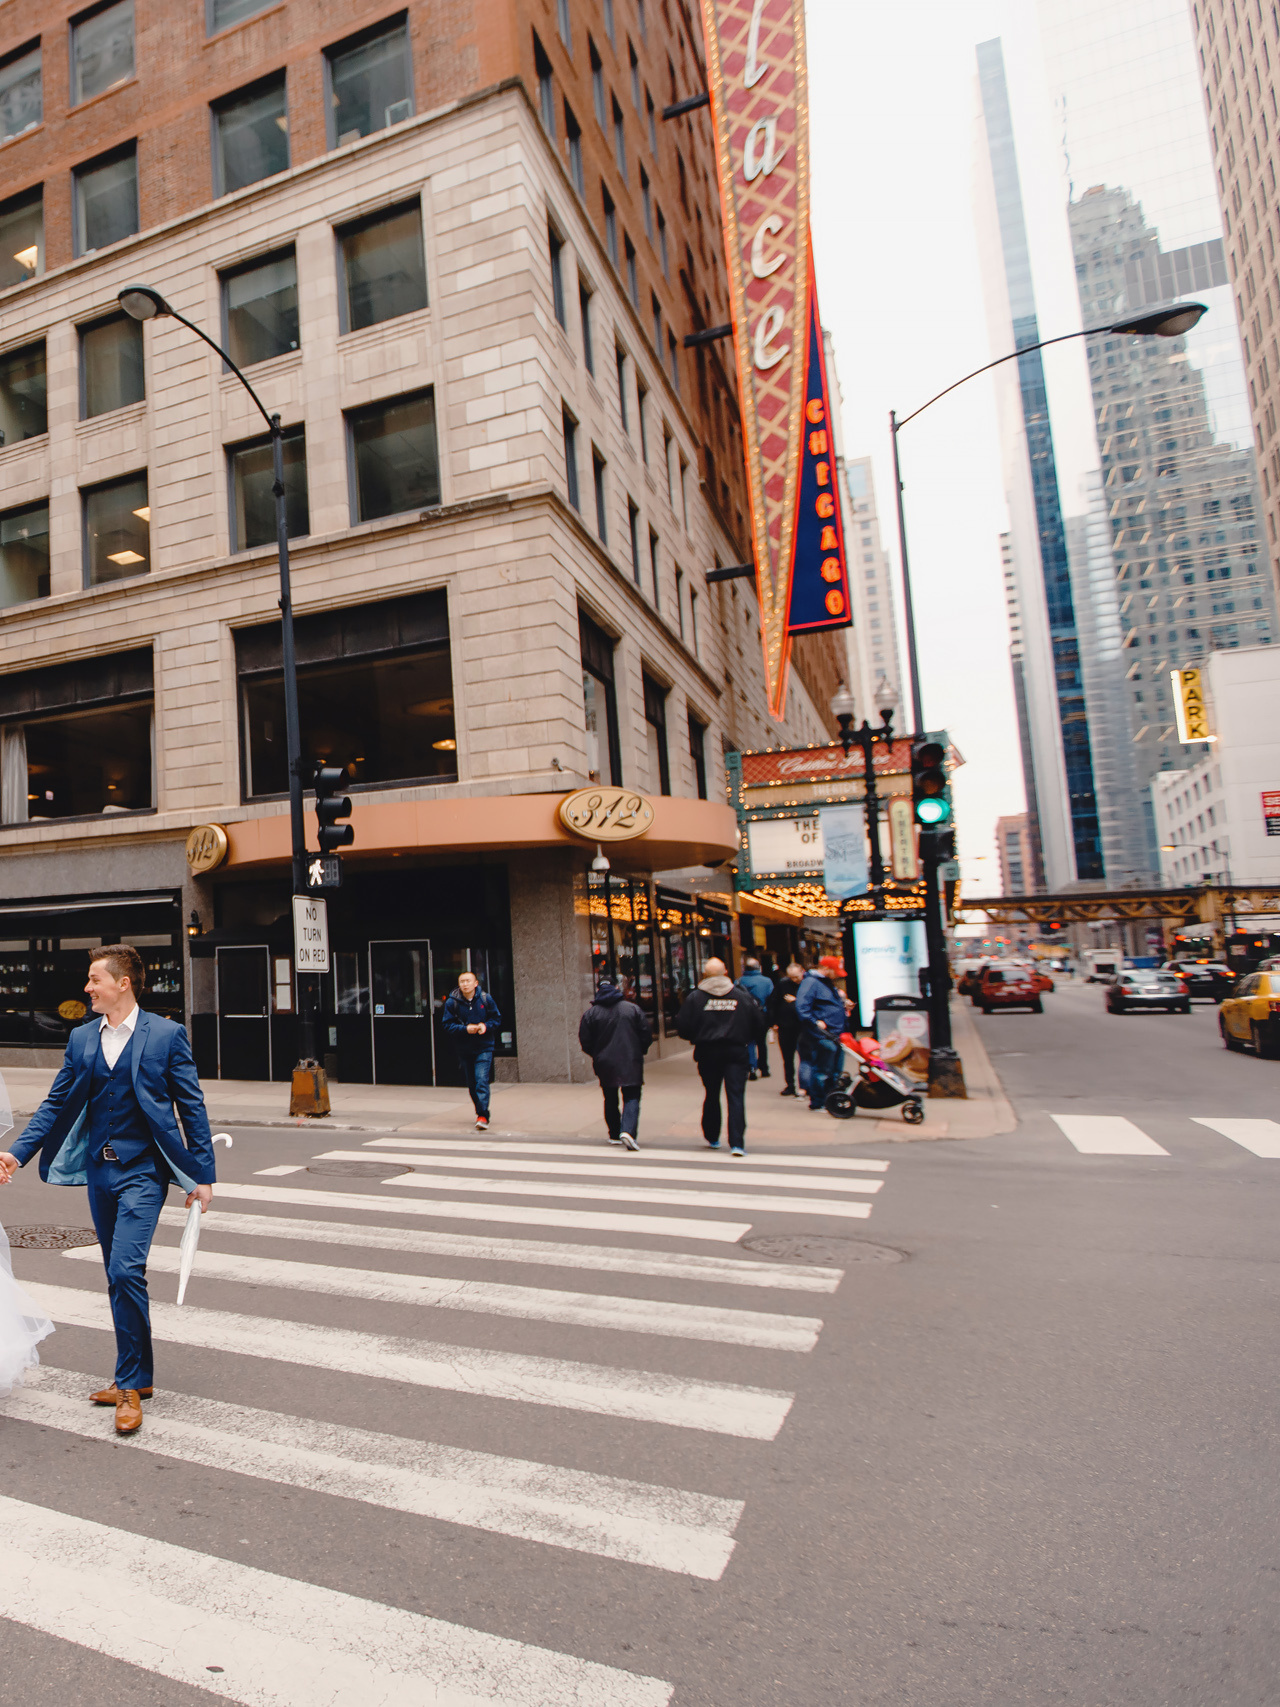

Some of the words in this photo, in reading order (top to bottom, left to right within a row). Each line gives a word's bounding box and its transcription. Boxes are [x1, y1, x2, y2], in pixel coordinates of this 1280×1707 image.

[806, 398, 845, 615] CHICAGO
[1183, 671, 1205, 738] PARK
[569, 810, 650, 818] CHICAGO
[573, 794, 642, 829] 312
[794, 820, 819, 832] THE
[801, 832, 819, 844] OF
[306, 907, 317, 921] NO
[303, 927, 322, 941] TURN
[300, 948, 310, 962] ON
[312, 949, 326, 963] RED
